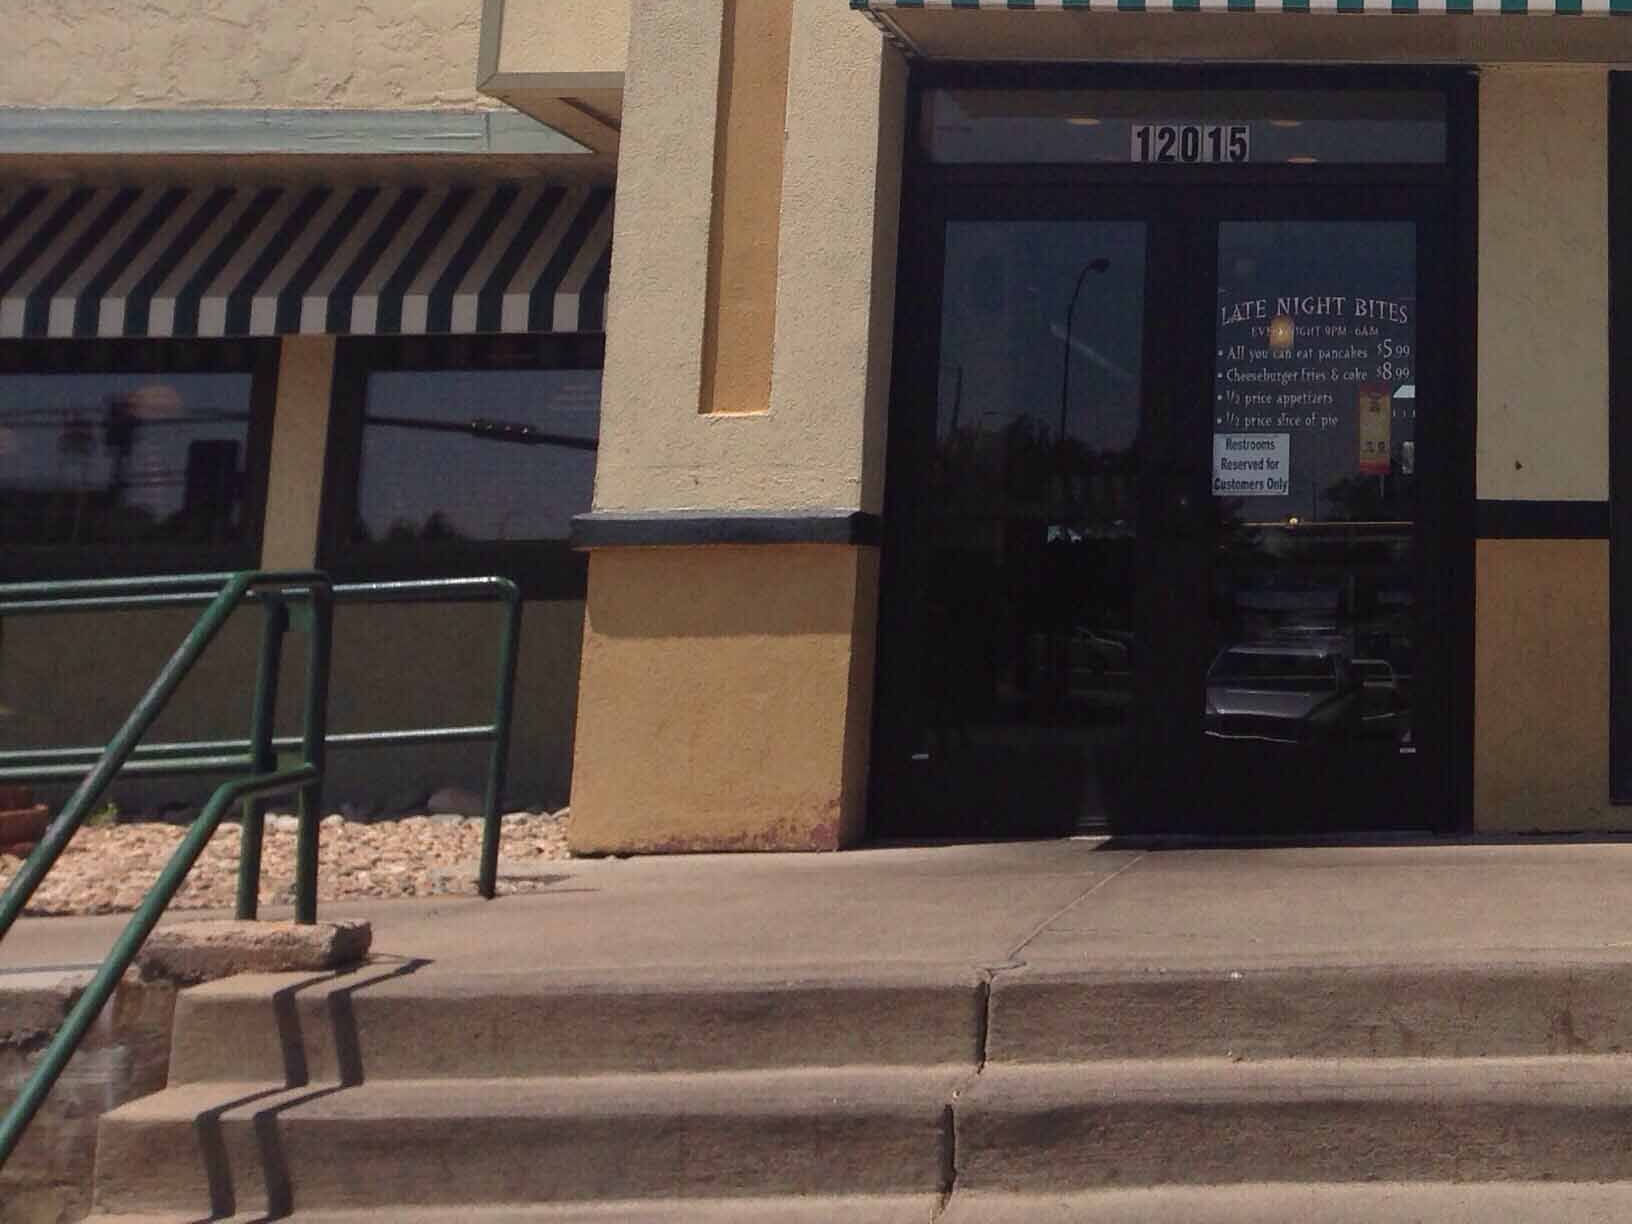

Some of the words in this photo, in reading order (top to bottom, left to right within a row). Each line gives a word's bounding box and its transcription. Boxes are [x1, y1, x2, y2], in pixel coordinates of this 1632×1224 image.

[1136, 126, 1248, 162] 12015
[1221, 299, 1267, 325] LATE
[1276, 296, 1346, 317] NIGHT
[1354, 298, 1409, 324] BITES
[1227, 345, 1245, 360] All
[1249, 349, 1268, 362] you
[1273, 349, 1292, 360] can
[1297, 347, 1313, 360] eat
[1319, 345, 1368, 362] pancakes
[1226, 368, 1298, 385] Cheeseburger
[1331, 367, 1339, 382] &
[1244, 393, 1272, 409] price
[1276, 393, 1333, 407] appetizers
[1244, 415, 1272, 430] price
[1277, 412, 1299, 426] slice
[1305, 412, 1318, 426] of
[1321, 415, 1339, 429] pie
[1225, 437, 1276, 451] Restrooms
[1220, 457, 1264, 471] Reserved
[1266, 457, 1280, 471] for
[1214, 477, 1265, 491] Customers
[1266, 477, 1289, 494] Only
